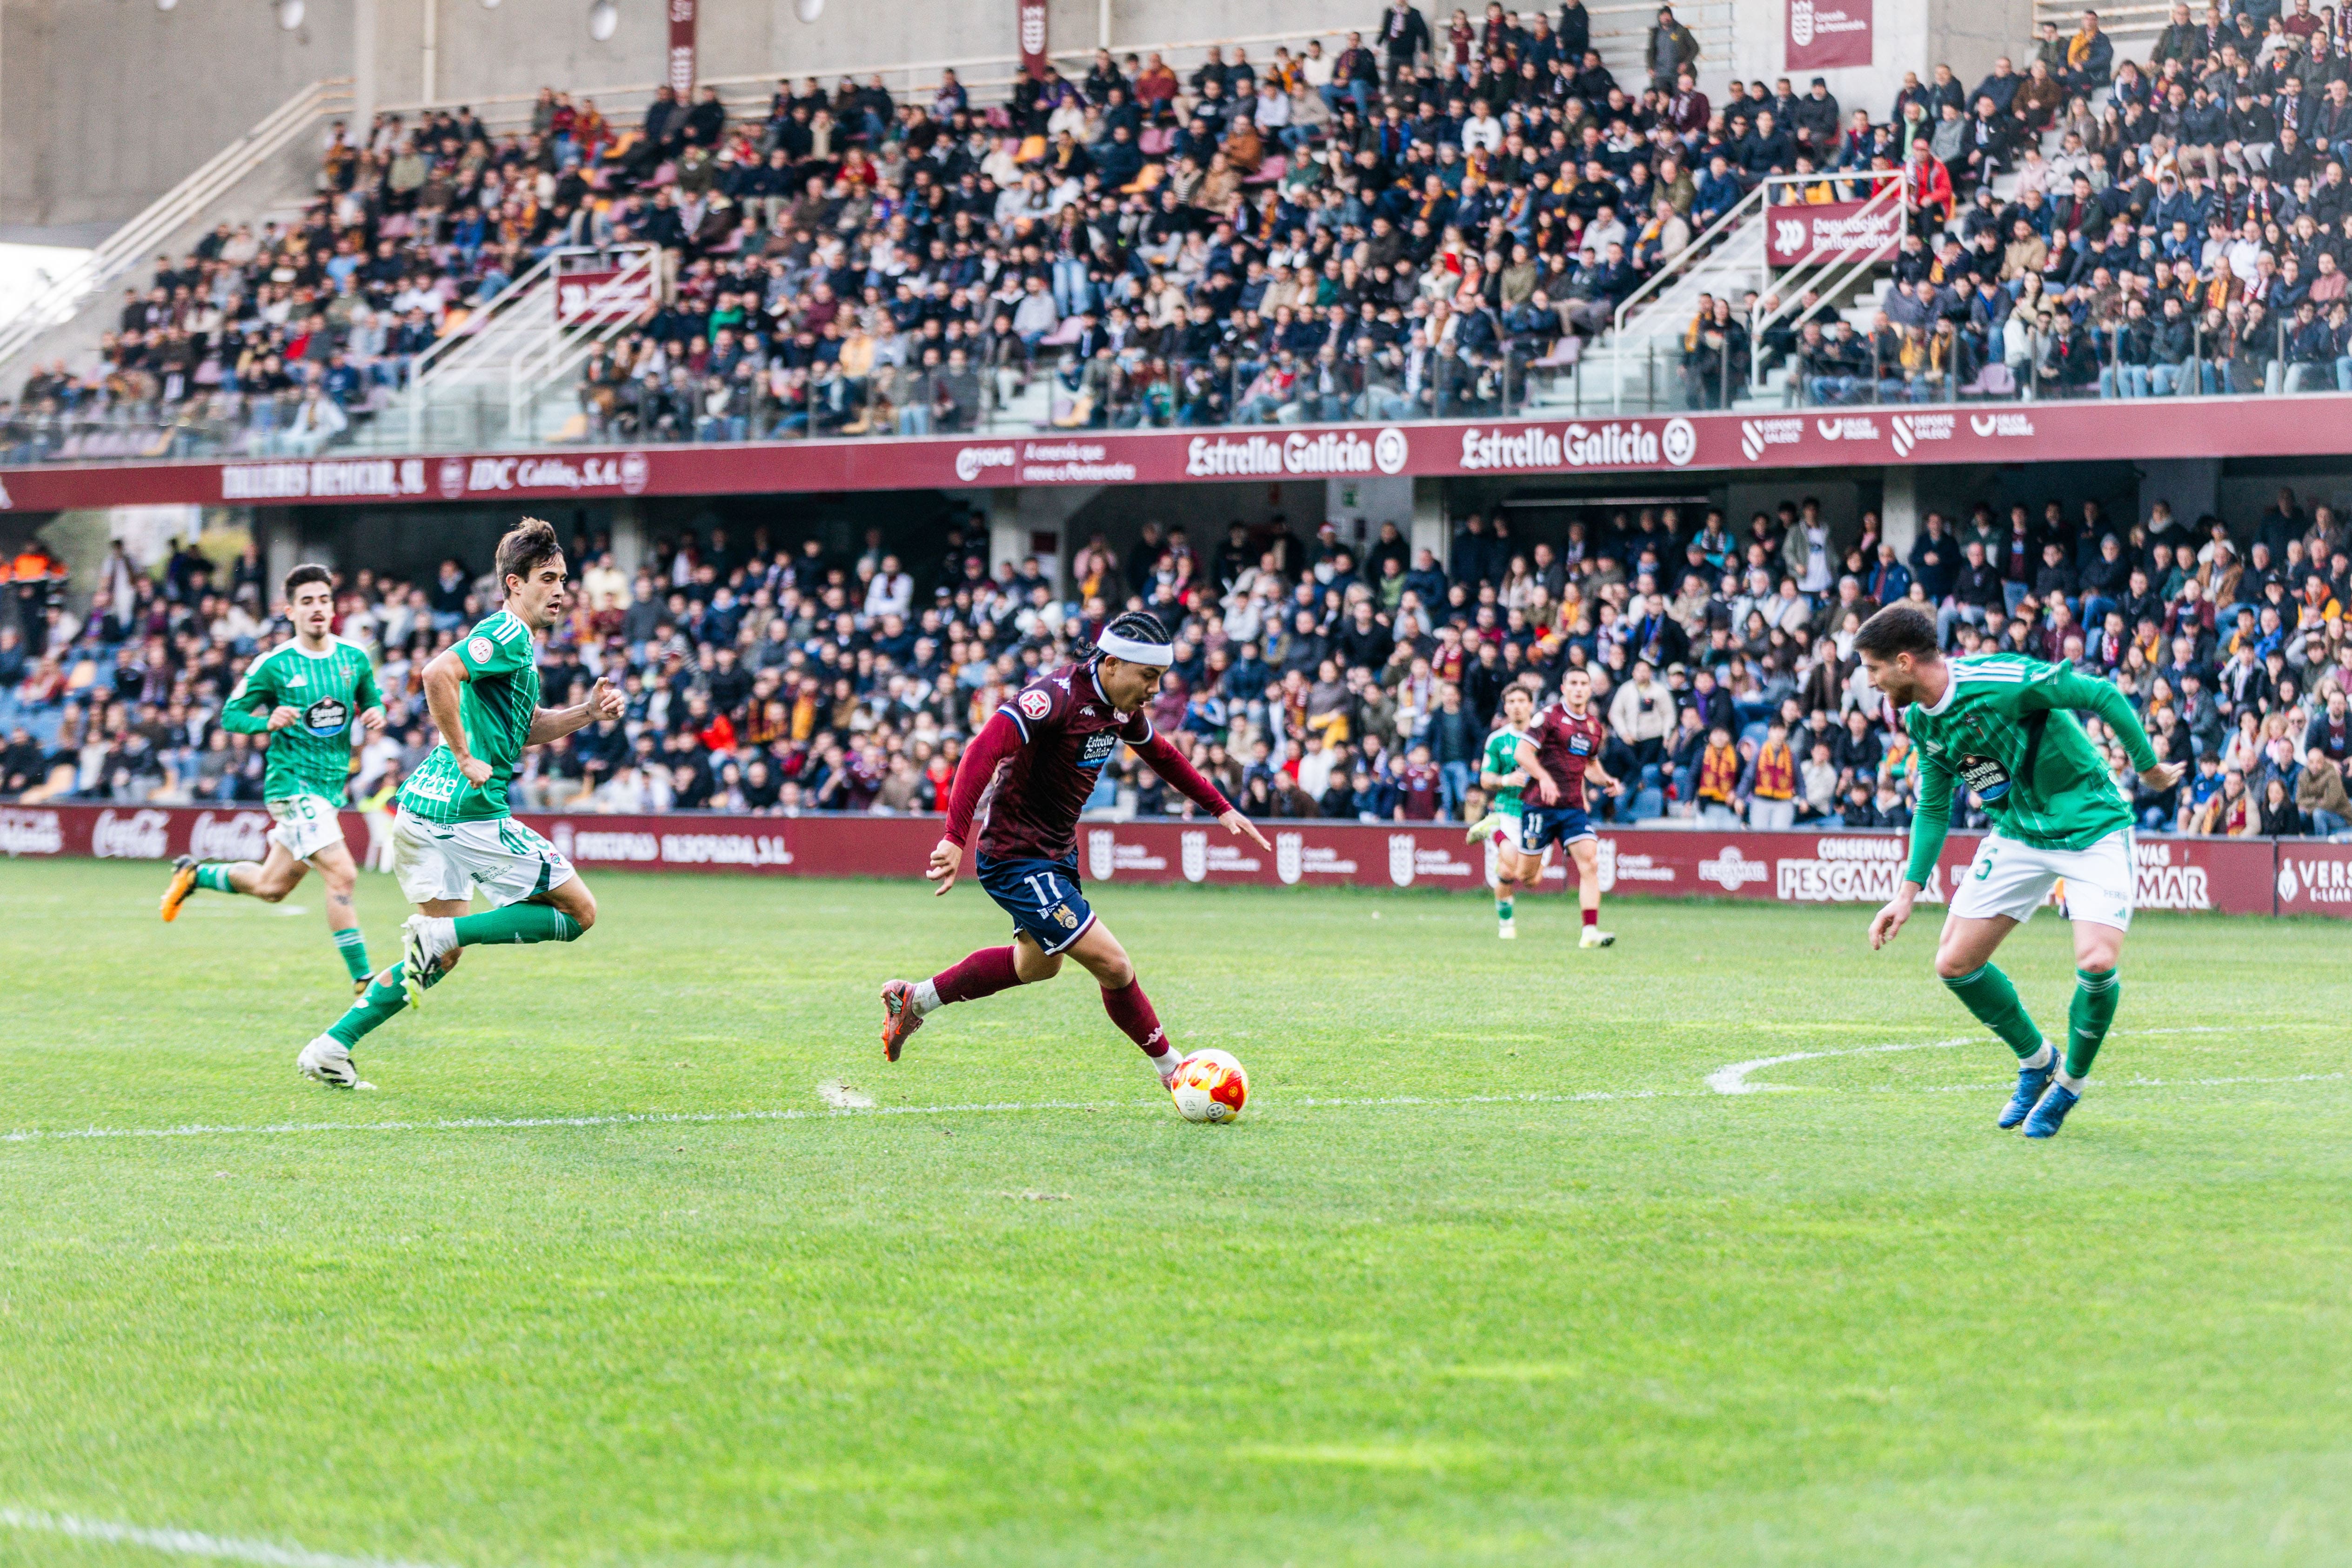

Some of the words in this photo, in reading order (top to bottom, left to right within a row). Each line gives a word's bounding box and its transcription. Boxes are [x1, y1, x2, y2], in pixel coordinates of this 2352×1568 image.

[1186, 436, 1283, 476] Estrella
[1283, 431, 1372, 474] Galicia
[1460, 427, 1561, 469] Estrella
[1563, 422, 1658, 466] Galicia
[1085, 735, 1115, 748] Estrella
[1084, 747, 1110, 760] Galicia
[300, 797, 316, 819] 6
[1529, 813, 1543, 834] 11
[1817, 838, 1904, 861] CONSERVAS
[490, 865, 513, 879] GALICIA
[1976, 847, 1998, 881] 5
[1024, 872, 1063, 906] 17
